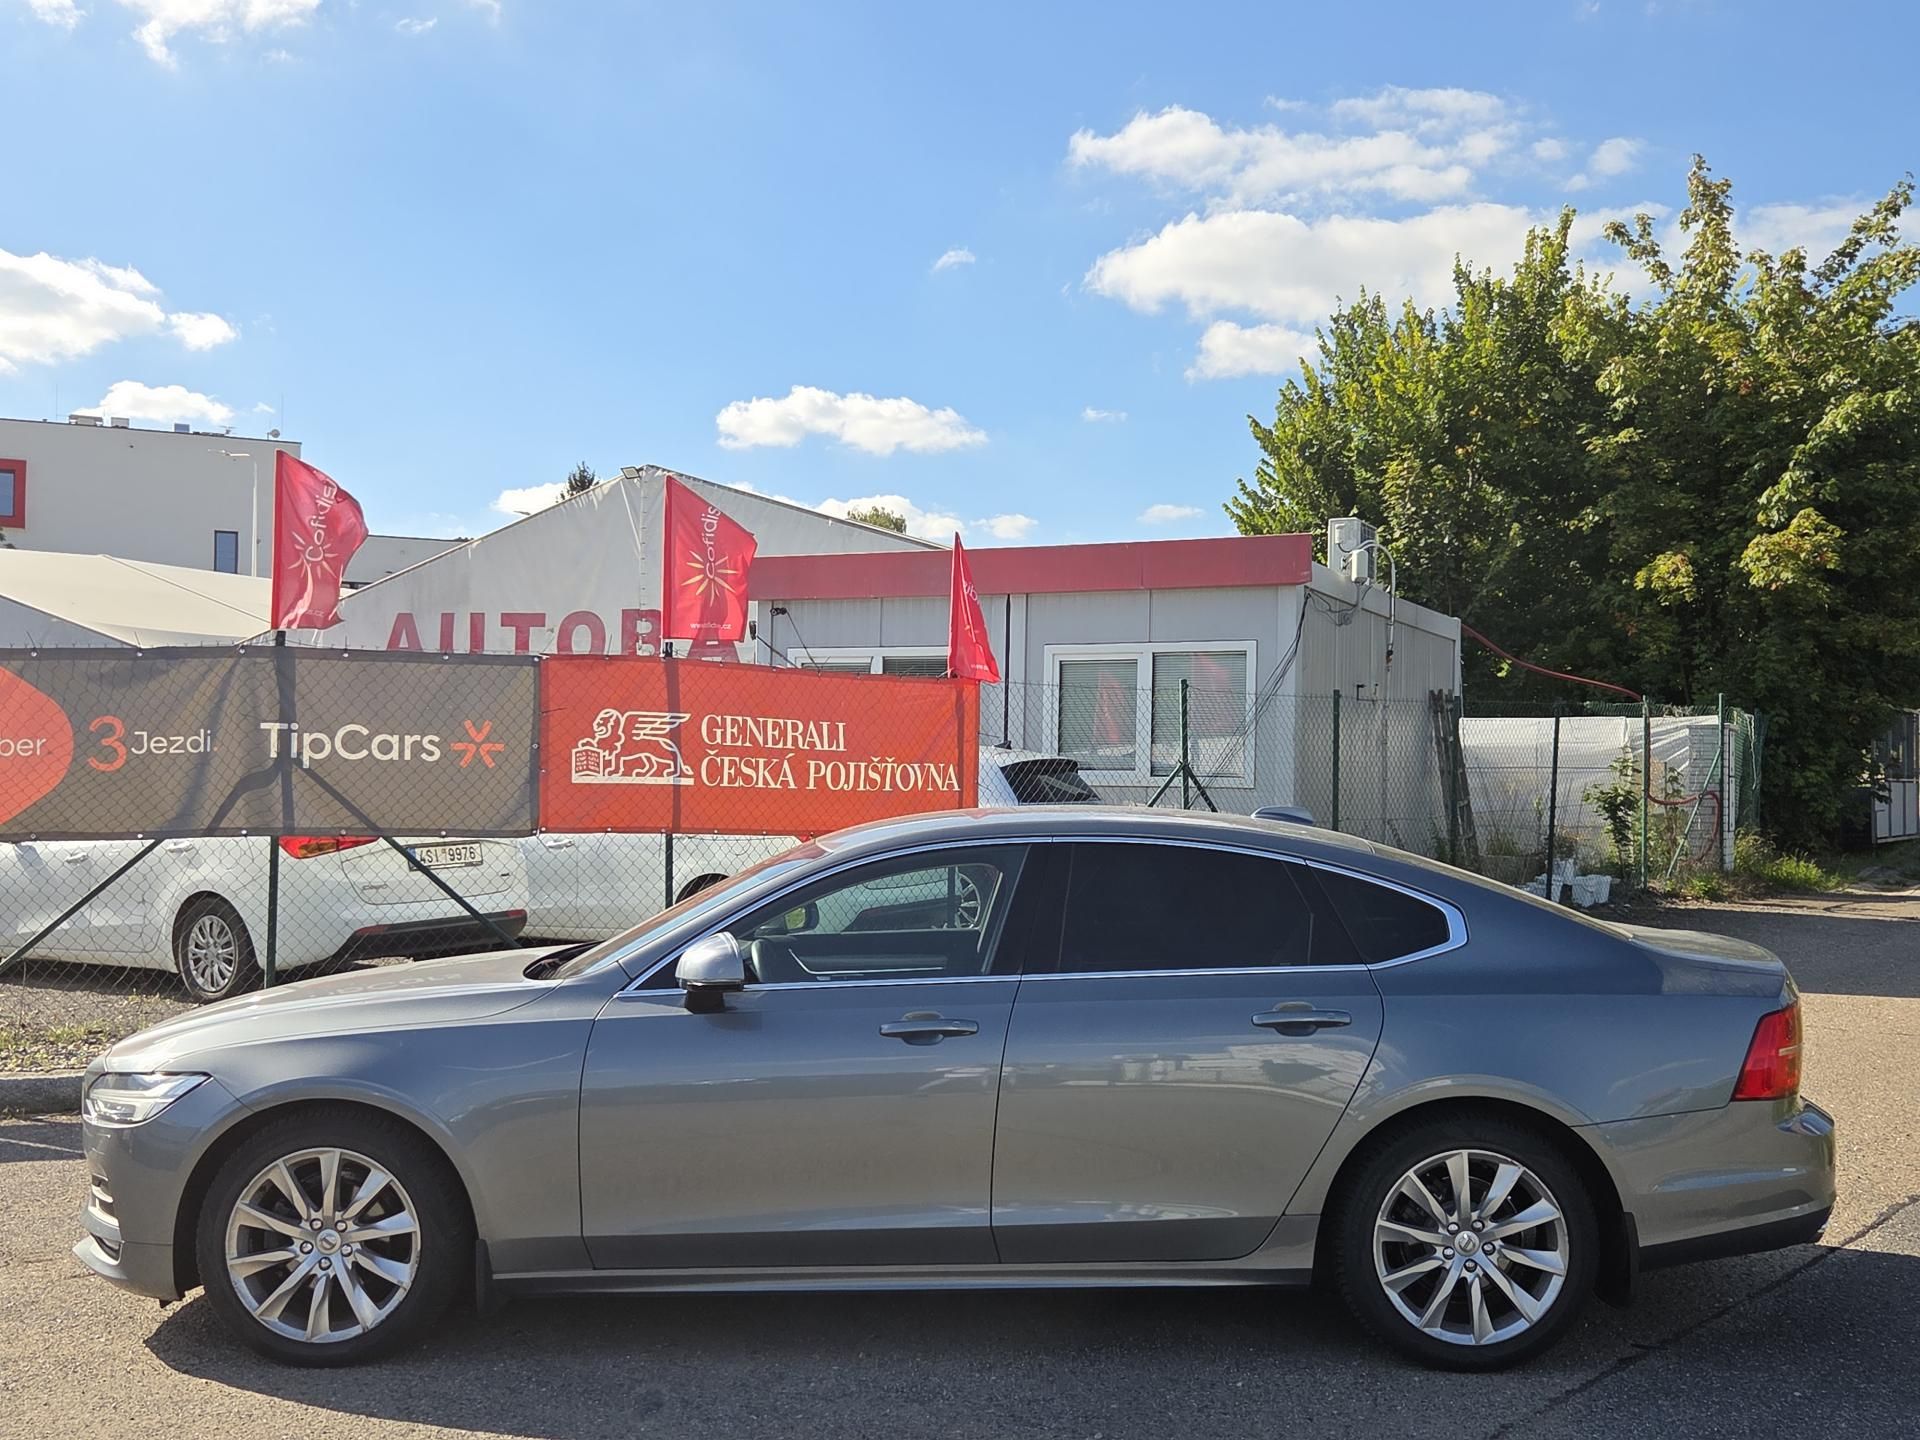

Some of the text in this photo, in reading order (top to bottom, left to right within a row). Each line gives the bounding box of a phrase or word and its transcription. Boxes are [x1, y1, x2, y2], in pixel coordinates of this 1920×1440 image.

[260, 722, 441, 769] TipCars
[701, 714, 848, 752] GENERALI
[701, 749, 961, 792] ČESKÁ POJIŠŤOVNA
